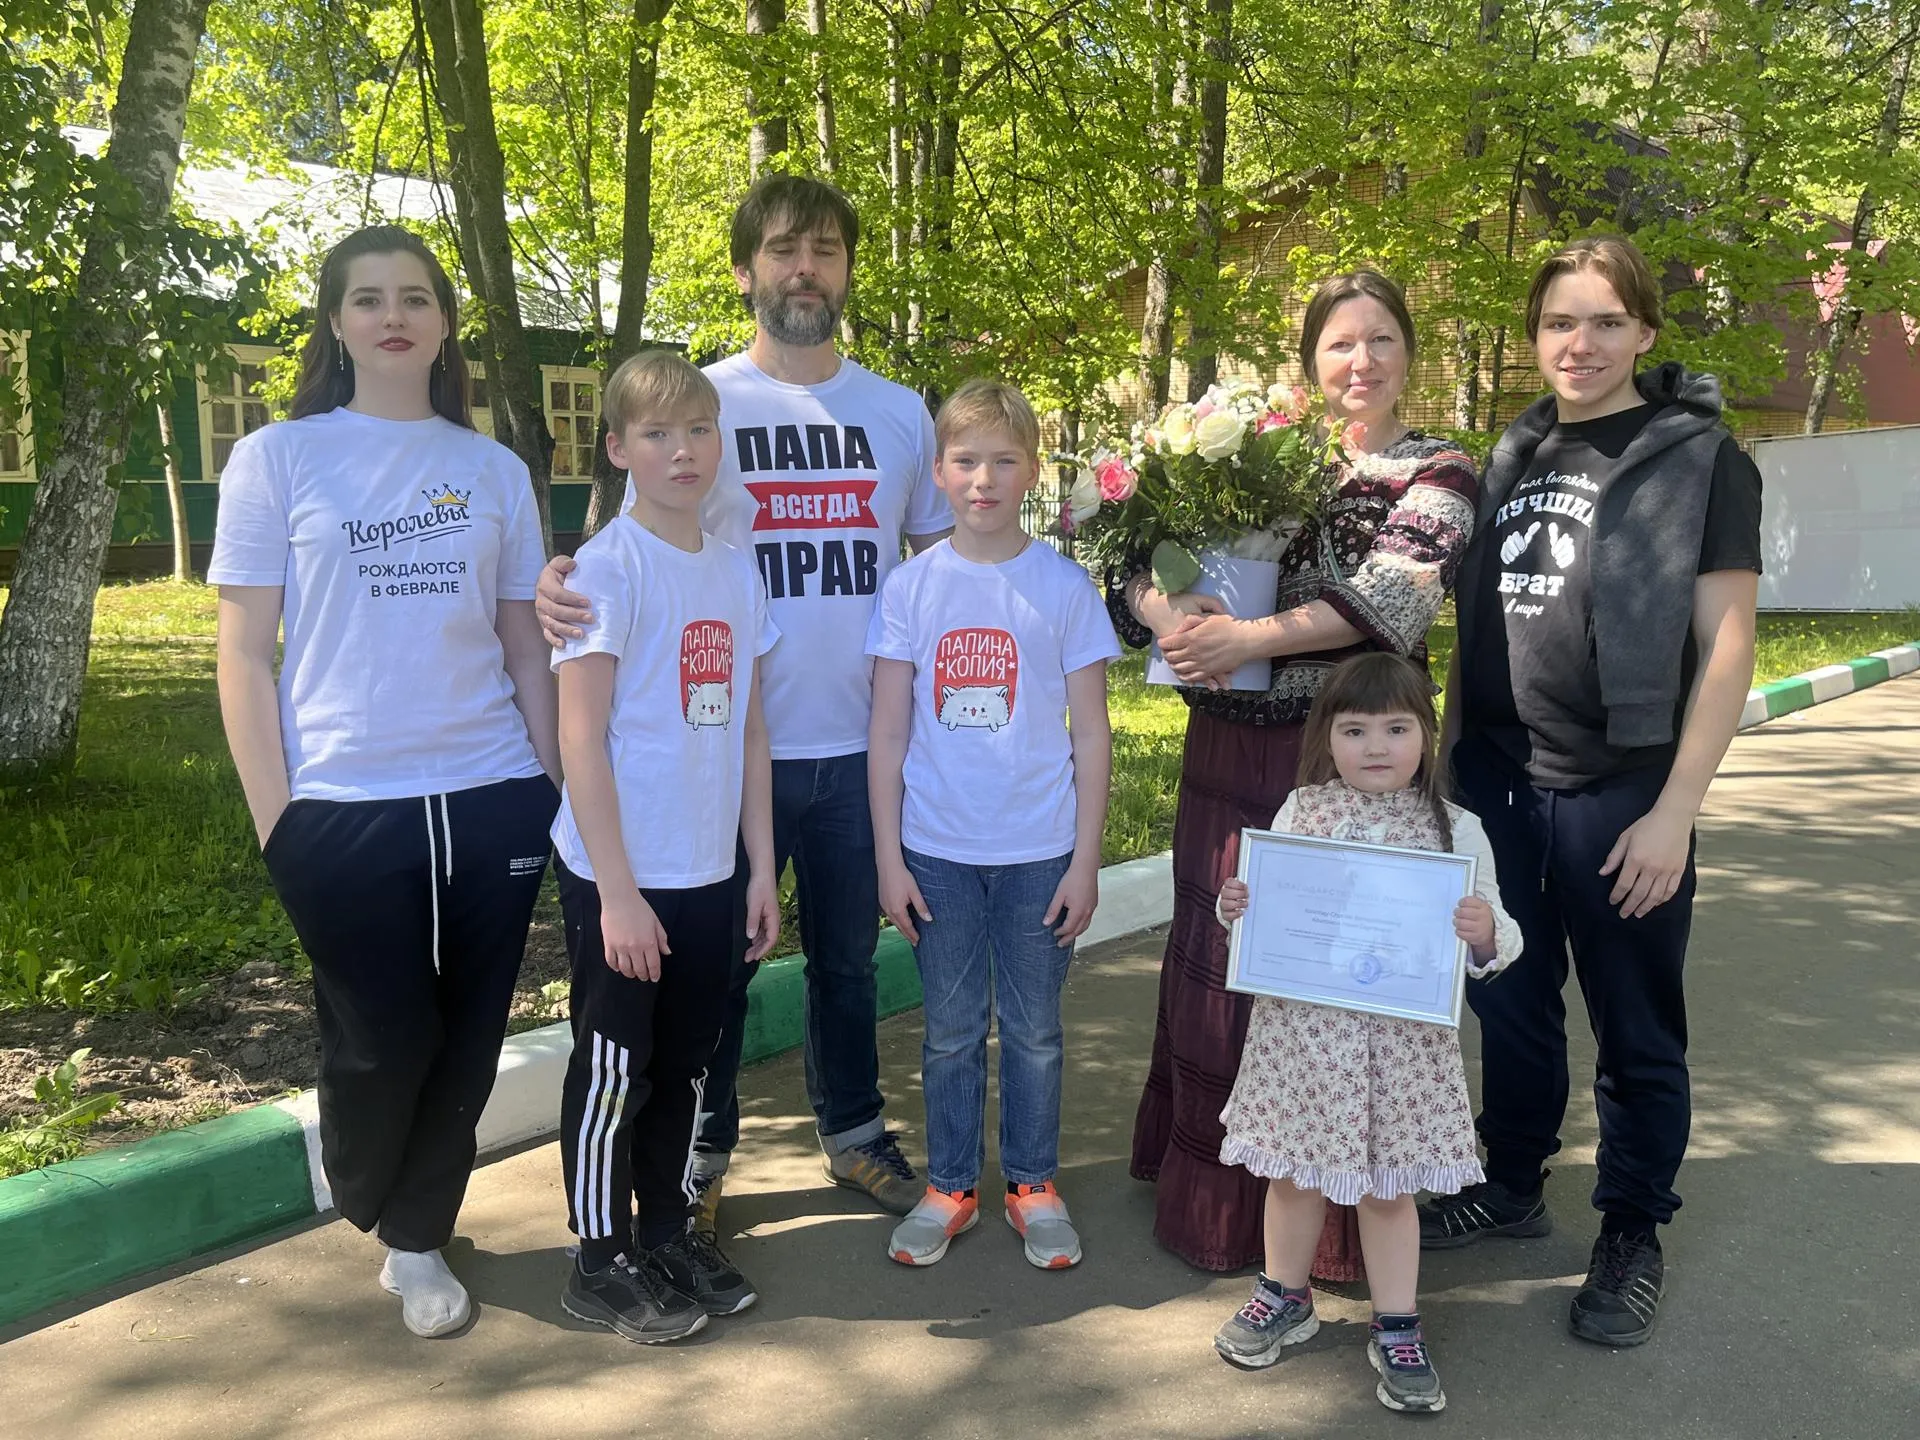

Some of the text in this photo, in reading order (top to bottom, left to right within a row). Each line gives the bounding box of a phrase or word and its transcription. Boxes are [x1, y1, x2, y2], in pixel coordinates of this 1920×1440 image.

[734, 424, 877, 473] ПАПА
[1519, 477, 1543, 490] так
[769, 492, 861, 523] ВСЕГДА
[1495, 491, 1595, 528] ЛУЧШИ
[341, 504, 470, 551] Королевы
[358, 561, 467, 579] РОЖДАЮТСЯ
[754, 539, 879, 600] ПРАВ
[371, 581, 460, 598] В ФЕВРАЛЕ
[1514, 604, 1544, 619] мире
[684, 624, 731, 653] ПАПИНА
[941, 632, 1013, 659] ПАПИНА
[689, 648, 729, 675] КОПИЯ
[946, 655, 1006, 681] КОПИЯ
